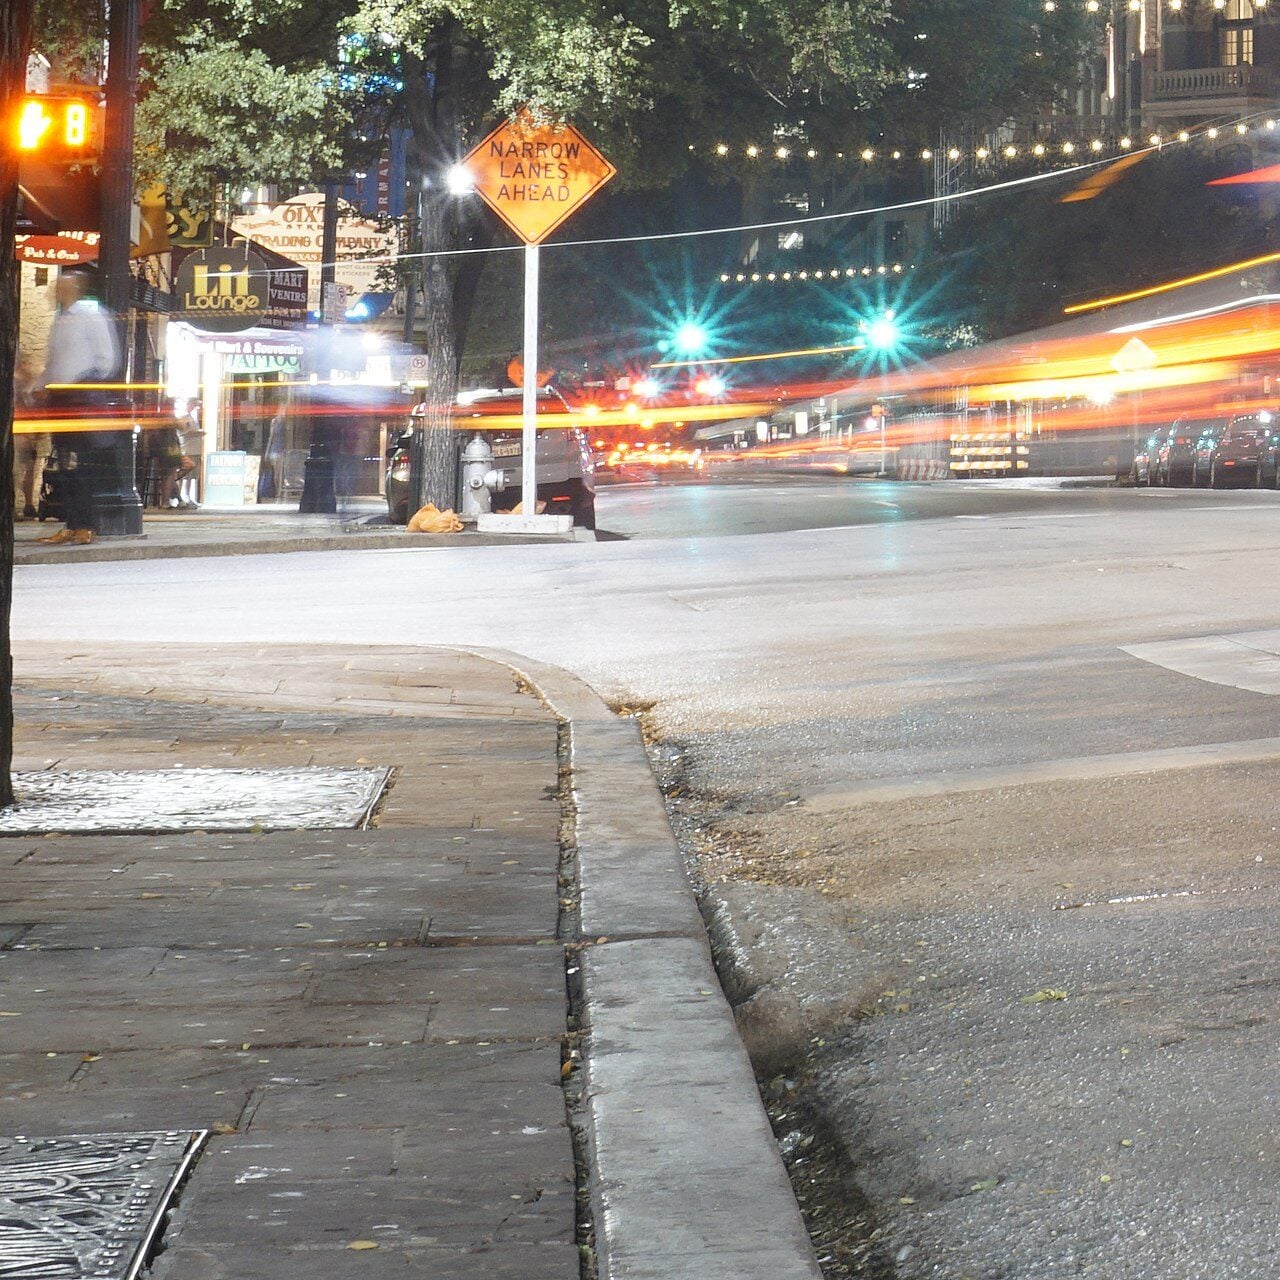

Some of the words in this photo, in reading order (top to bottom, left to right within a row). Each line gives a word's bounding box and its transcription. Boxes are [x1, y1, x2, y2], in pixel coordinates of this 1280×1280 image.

[490, 141, 580, 159] NARROW
[500, 163, 569, 180] LANES
[497, 184, 570, 202] AHEAD
[251, 233, 310, 247] TRADING
[316, 235, 382, 248] CMPANY
[24, 246, 45, 258] Pub
[46, 248, 56, 259] &
[193, 264, 249, 297] Lit
[274, 271, 304, 288] MART
[185, 292, 260, 312] Lounge
[269, 291, 306, 303] VENIRS
[243, 341, 252, 353] &
[254, 341, 304, 355] Souvenirs
